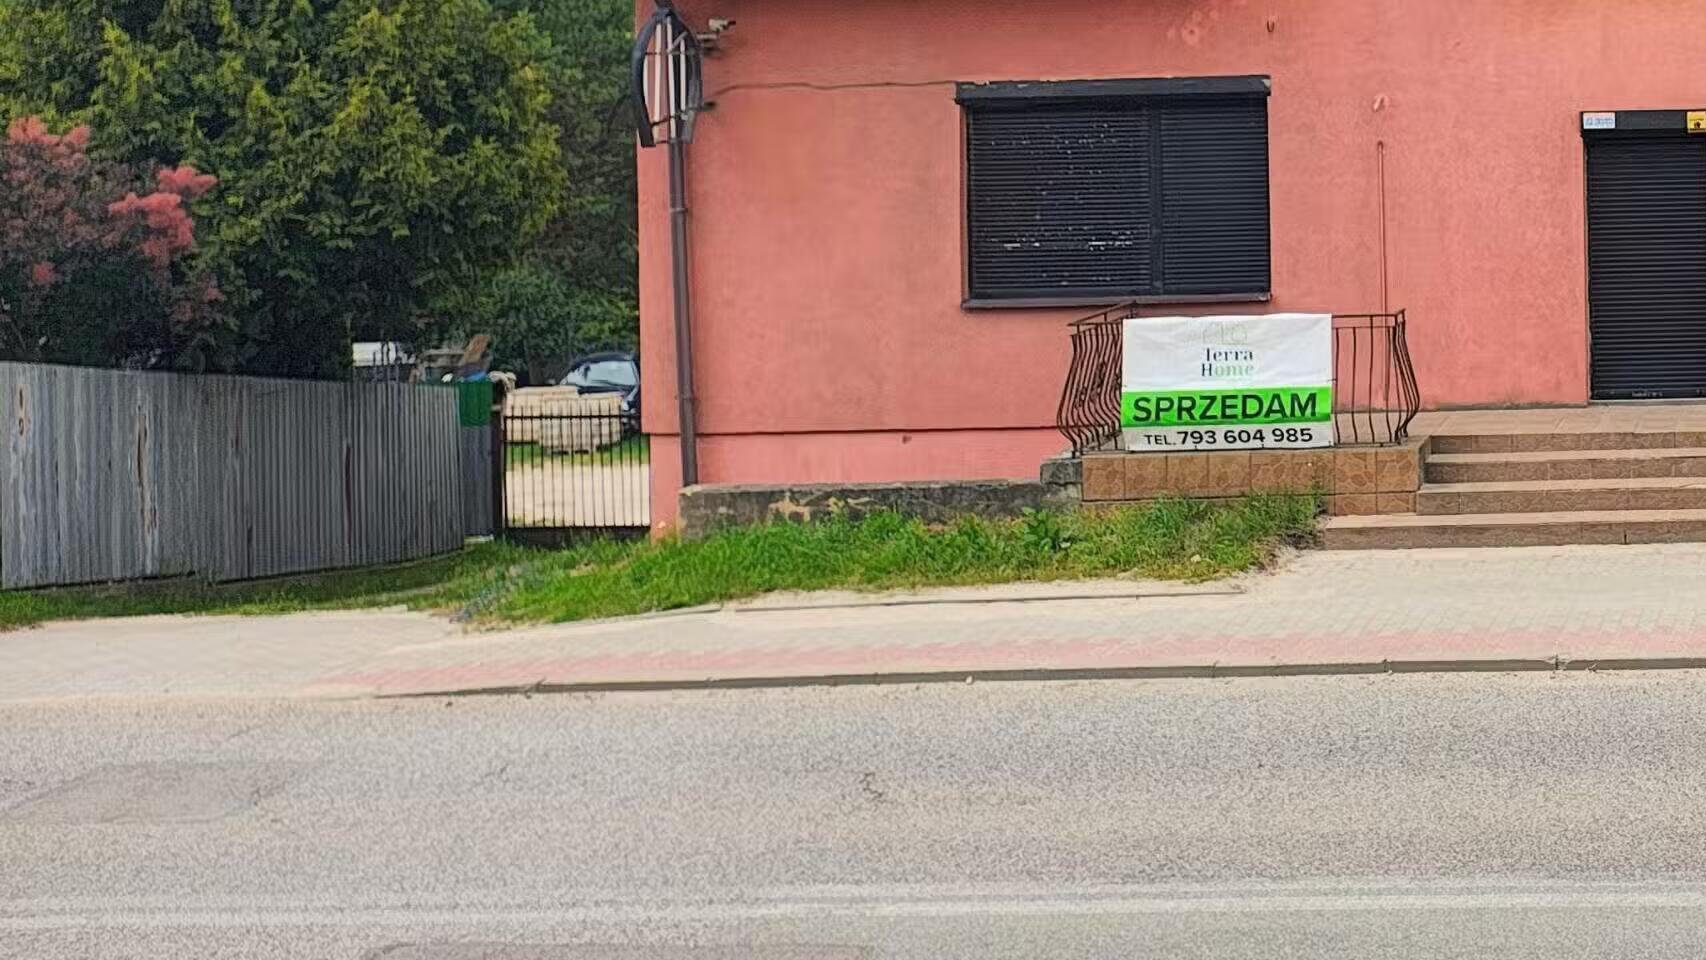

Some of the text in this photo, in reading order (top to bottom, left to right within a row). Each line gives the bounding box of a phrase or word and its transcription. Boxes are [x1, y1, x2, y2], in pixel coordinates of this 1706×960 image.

[1203, 347, 1253, 362] Terra
[1132, 392, 1318, 423] SPRZEDAM
[1223, 429, 1265, 444] 604
[1271, 427, 1313, 443] 985
